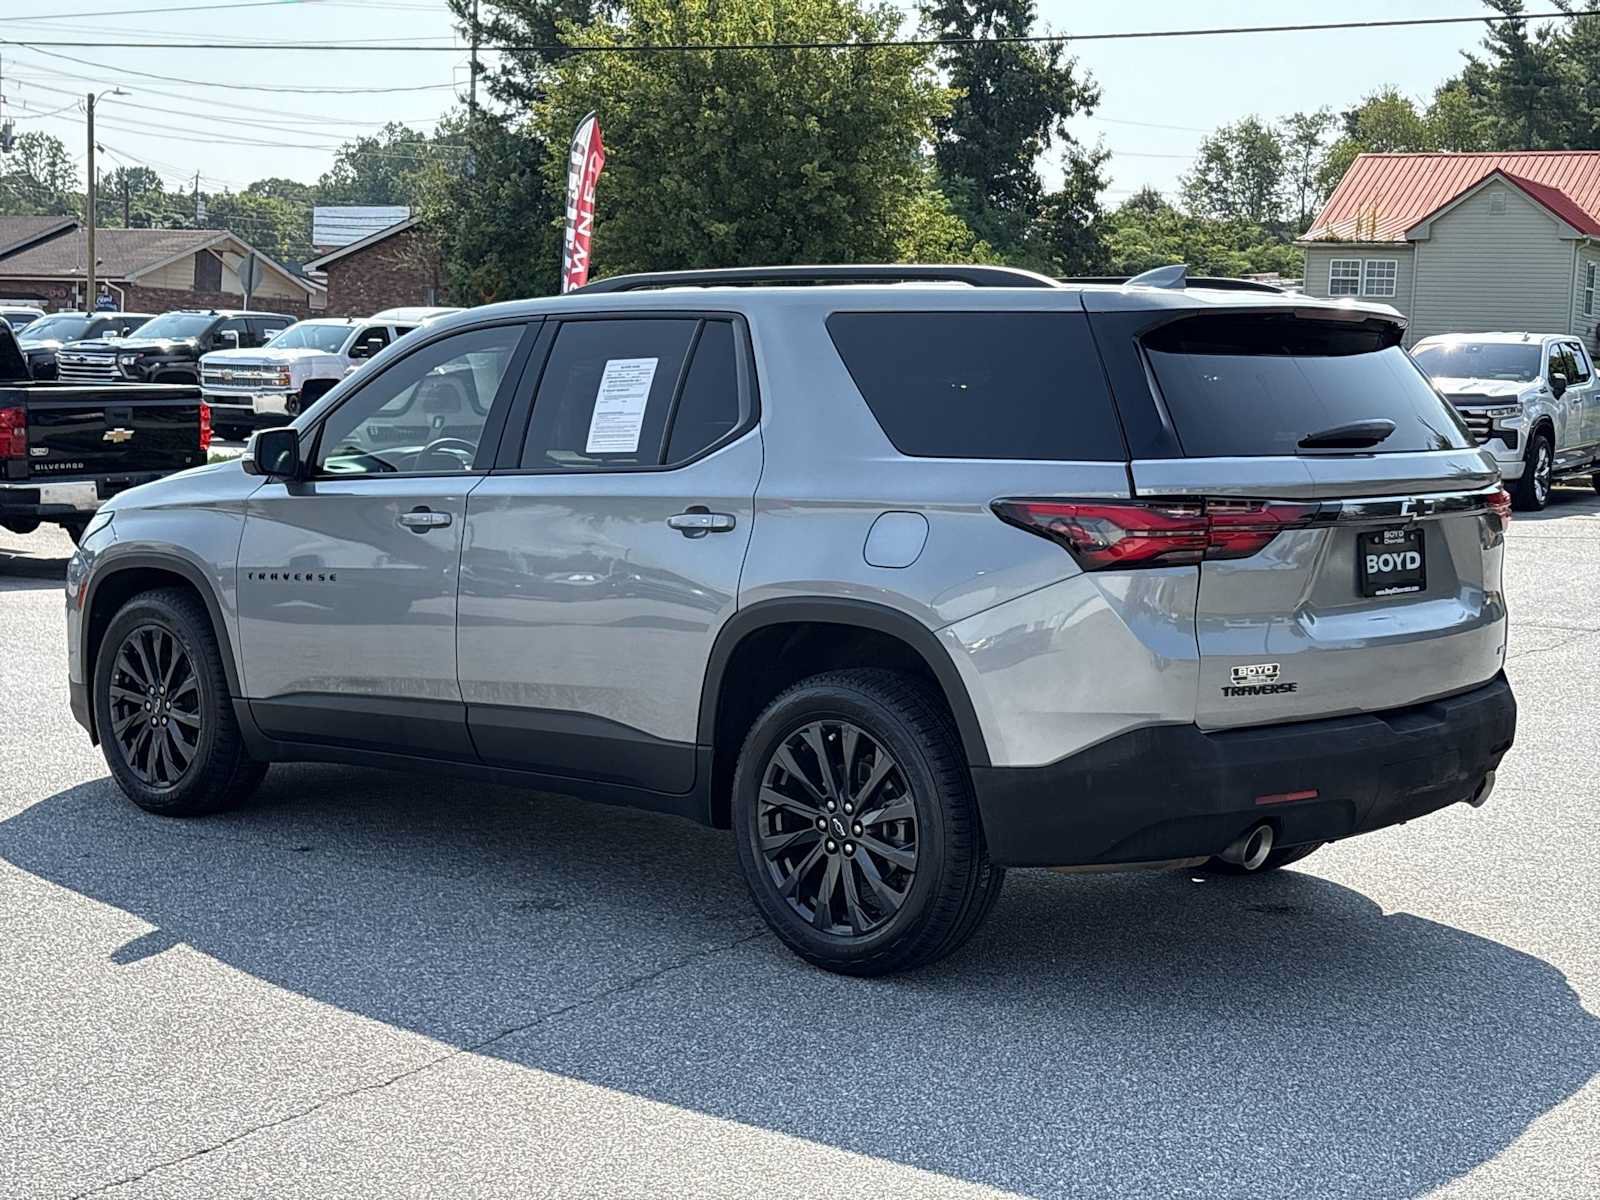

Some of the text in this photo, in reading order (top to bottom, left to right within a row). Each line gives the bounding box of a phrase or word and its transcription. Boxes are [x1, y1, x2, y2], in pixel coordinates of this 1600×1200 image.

[1383, 530, 1405, 538] BOYD
[1366, 551, 1421, 574] BOYD
[248, 572, 337, 581] TRAVERSE
[1238, 666, 1273, 676] BOYD
[1221, 682, 1298, 697] TRAVERSE
